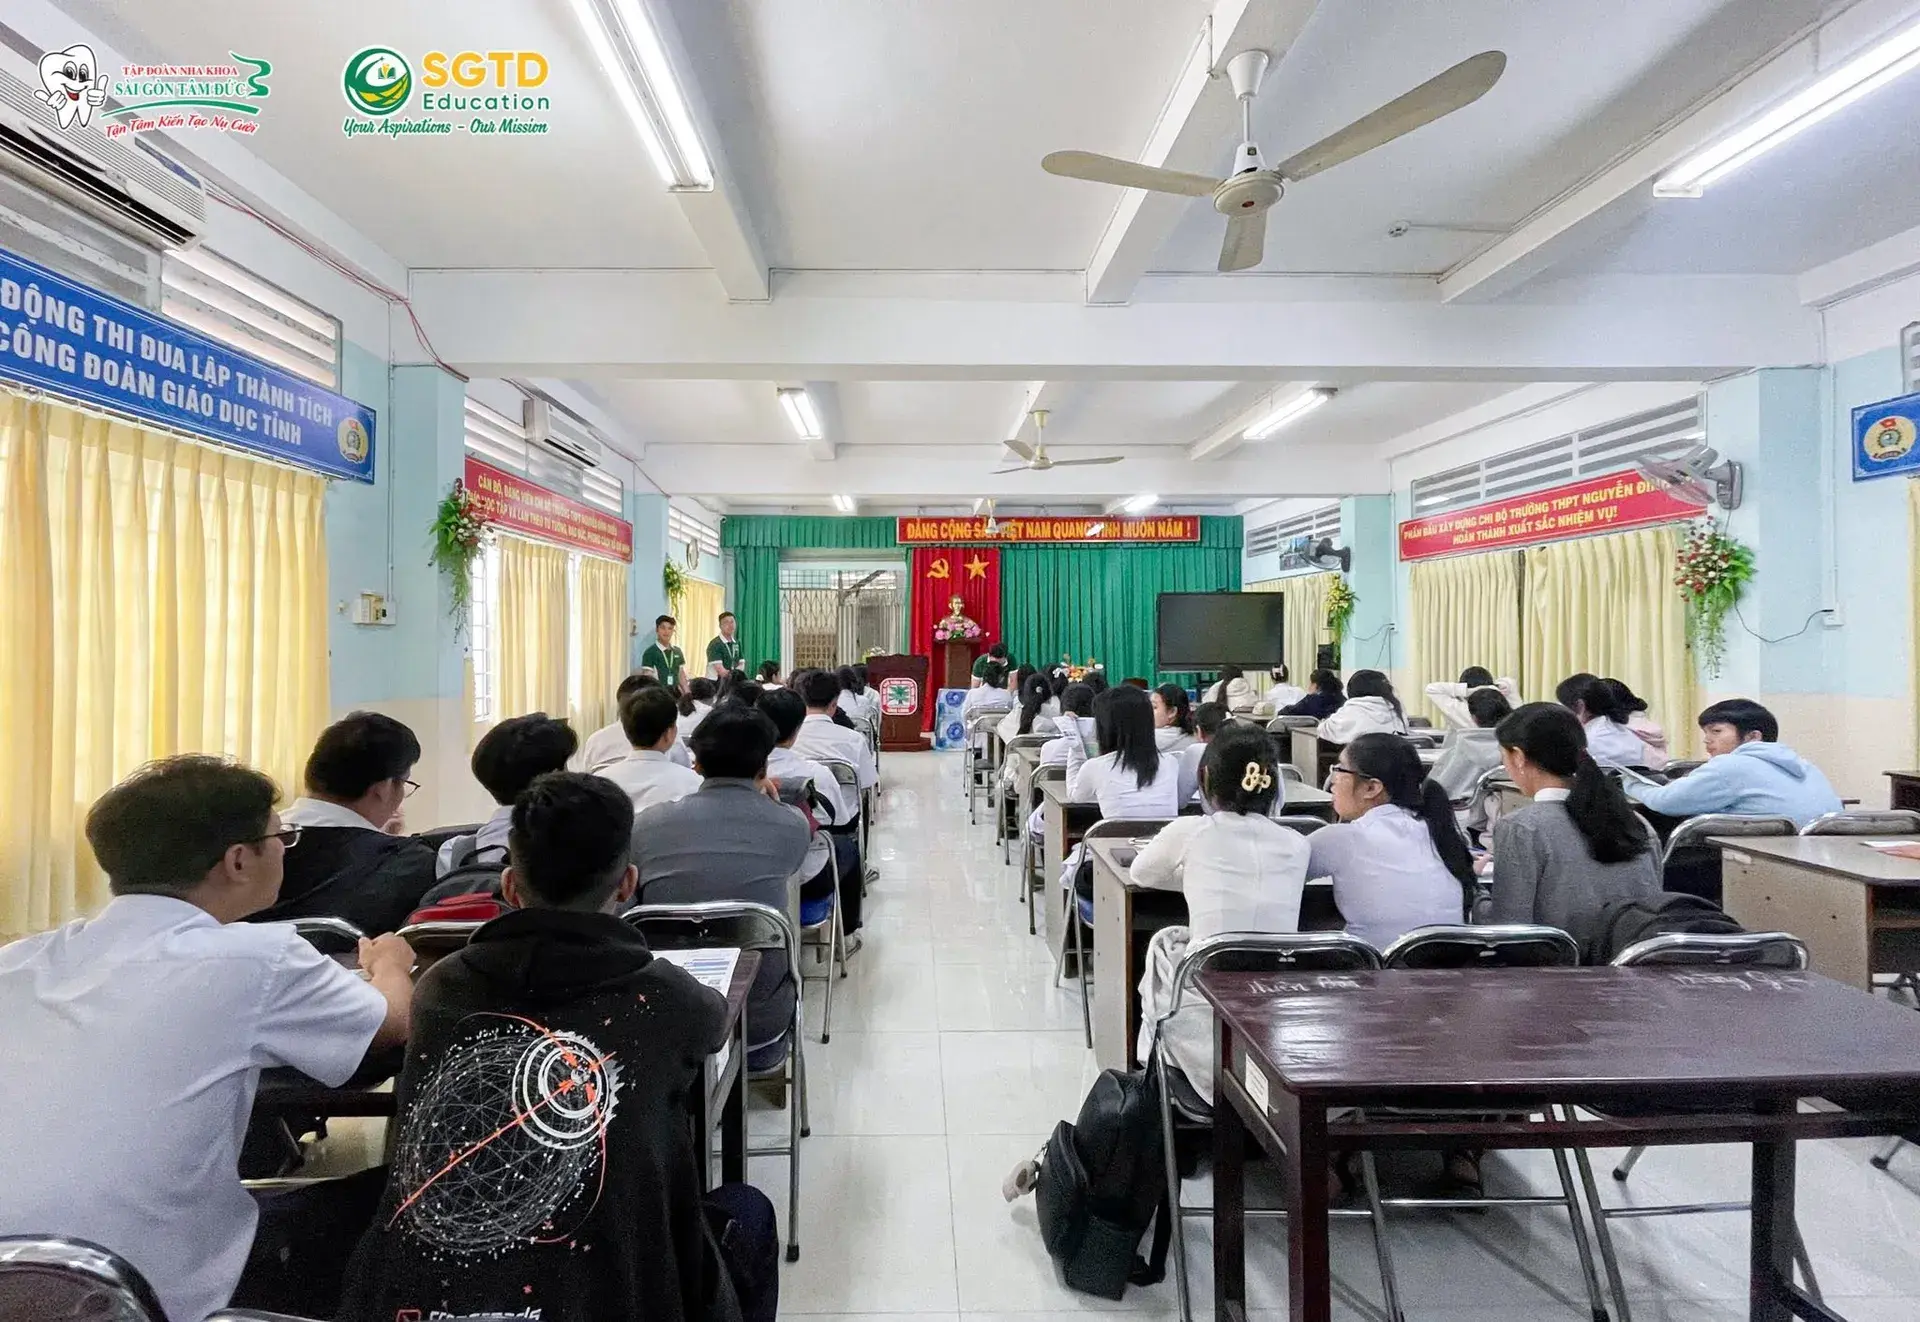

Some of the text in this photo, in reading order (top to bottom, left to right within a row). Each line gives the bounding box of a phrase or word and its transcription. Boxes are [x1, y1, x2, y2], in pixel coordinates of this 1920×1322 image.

[0, 278, 333, 428] ĐỘNG THI ĐUA LẬP THÀNH TÍCH
[83, 350, 155, 400] ĐOÀN
[162, 379, 213, 418] GIÁO
[220, 398, 258, 433] DỤC
[262, 410, 301, 446] TỈNH
[906, 517, 938, 539] ĐẢNG
[940, 519, 970, 541] CỘNG
[1026, 522, 1050, 538] NAM
[1123, 518, 1155, 538] MUÔN
[1157, 518, 1183, 538] NĂM
[1453, 505, 1618, 545] HOÀN THÀNH XUẤT SẮC NHIỆM VỤ!
[1455, 516, 1478, 532] DỰNG
[1480, 512, 1493, 526] CHI
[1495, 508, 1507, 524] BỘ
[1510, 500, 1549, 519] TRƯỜNG
[1552, 495, 1580, 511] THPT
[1582, 480, 1633, 505] NGUYỄN
